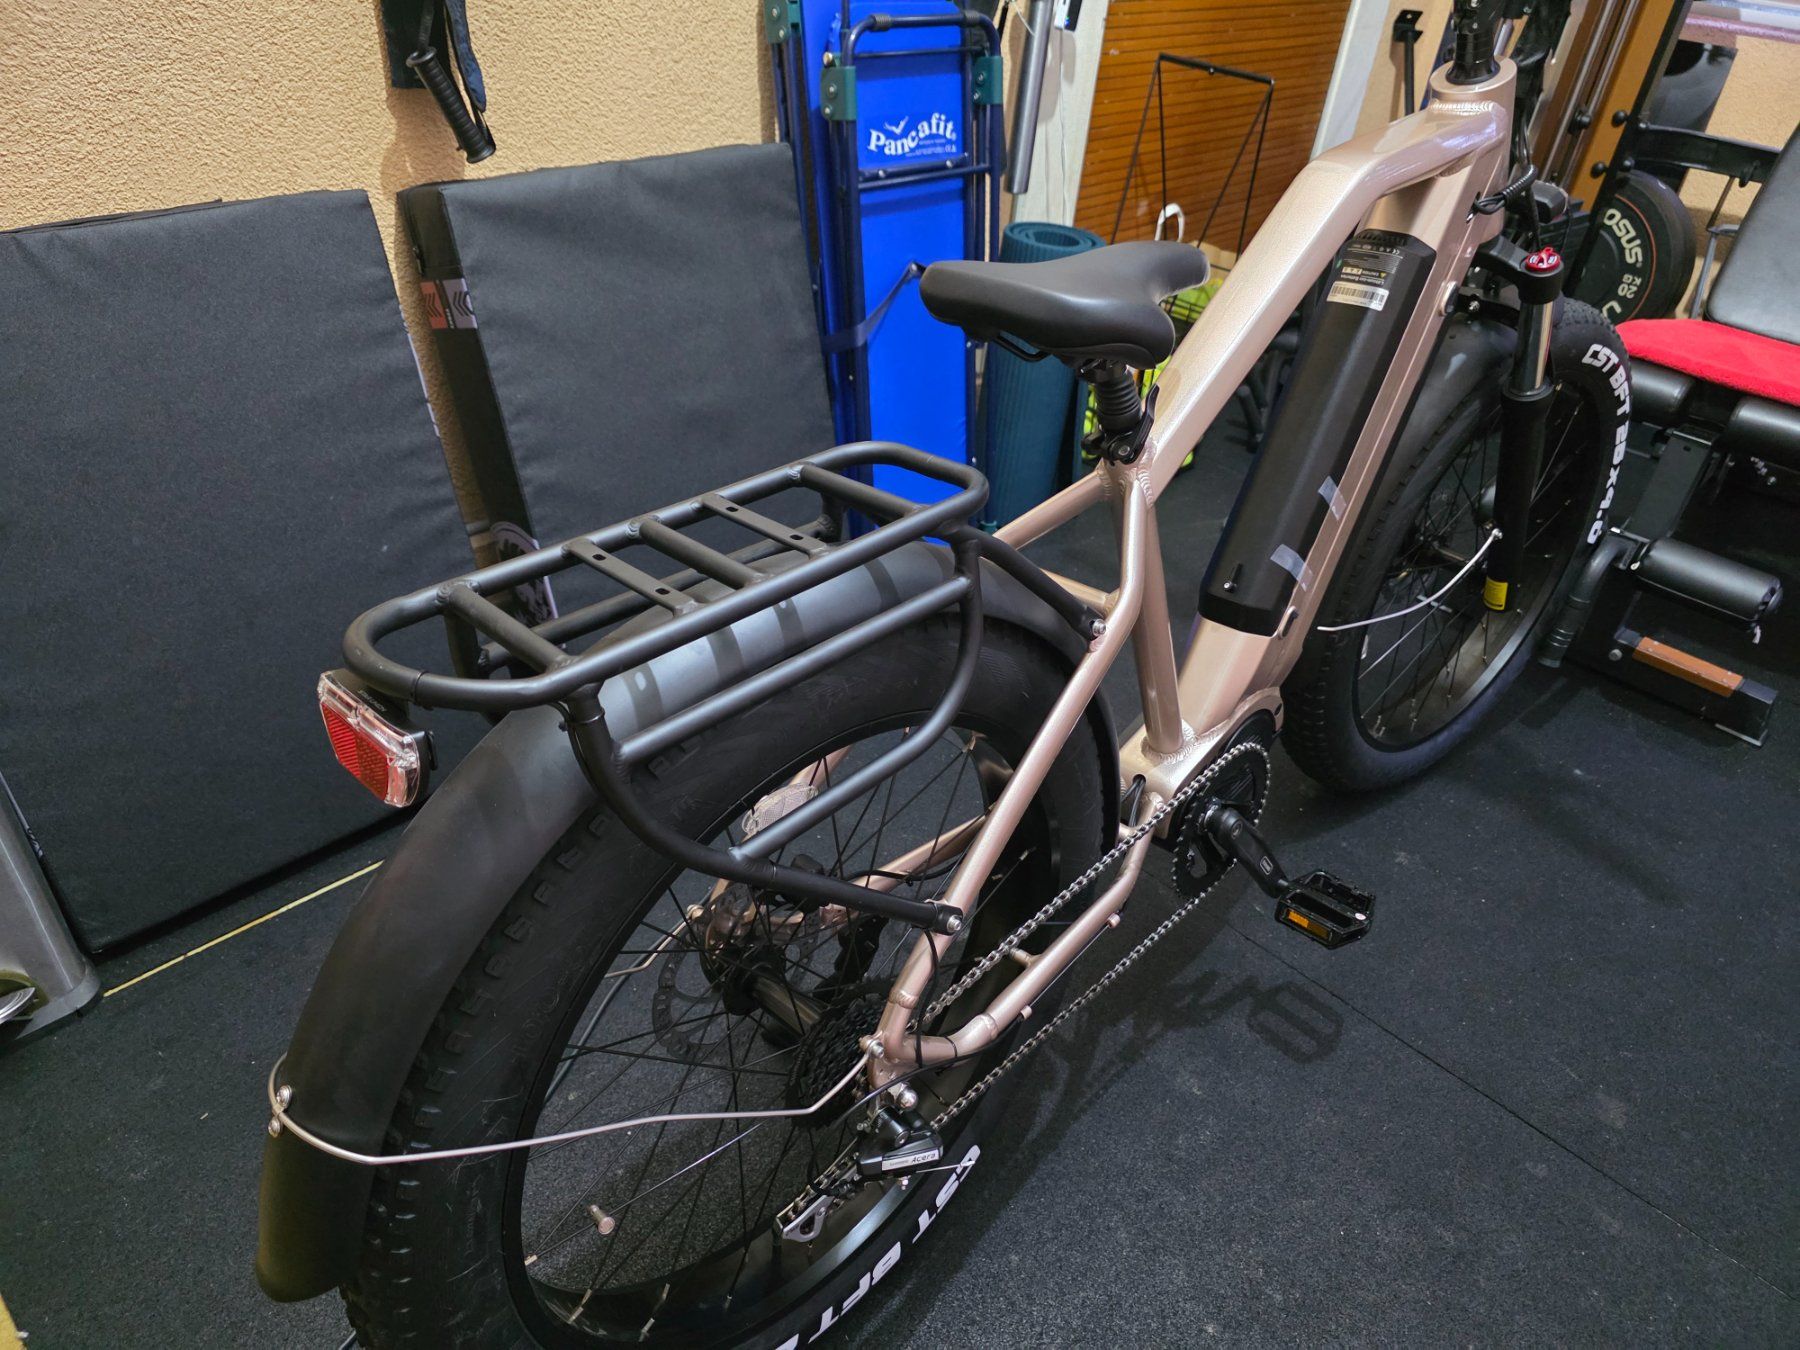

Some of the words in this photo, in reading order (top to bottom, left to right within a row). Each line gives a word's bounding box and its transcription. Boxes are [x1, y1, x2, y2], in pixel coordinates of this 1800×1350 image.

[867, 112, 954, 156] Pancafit
[1617, 284, 1638, 299] 20
[1622, 273, 1642, 286] KG
[1581, 343, 1619, 373] CST
[1609, 365, 1631, 416] BFT
[911, 1151, 936, 1164] Acera
[912, 1144, 981, 1244] CST
[807, 1241, 902, 1344] BFT
